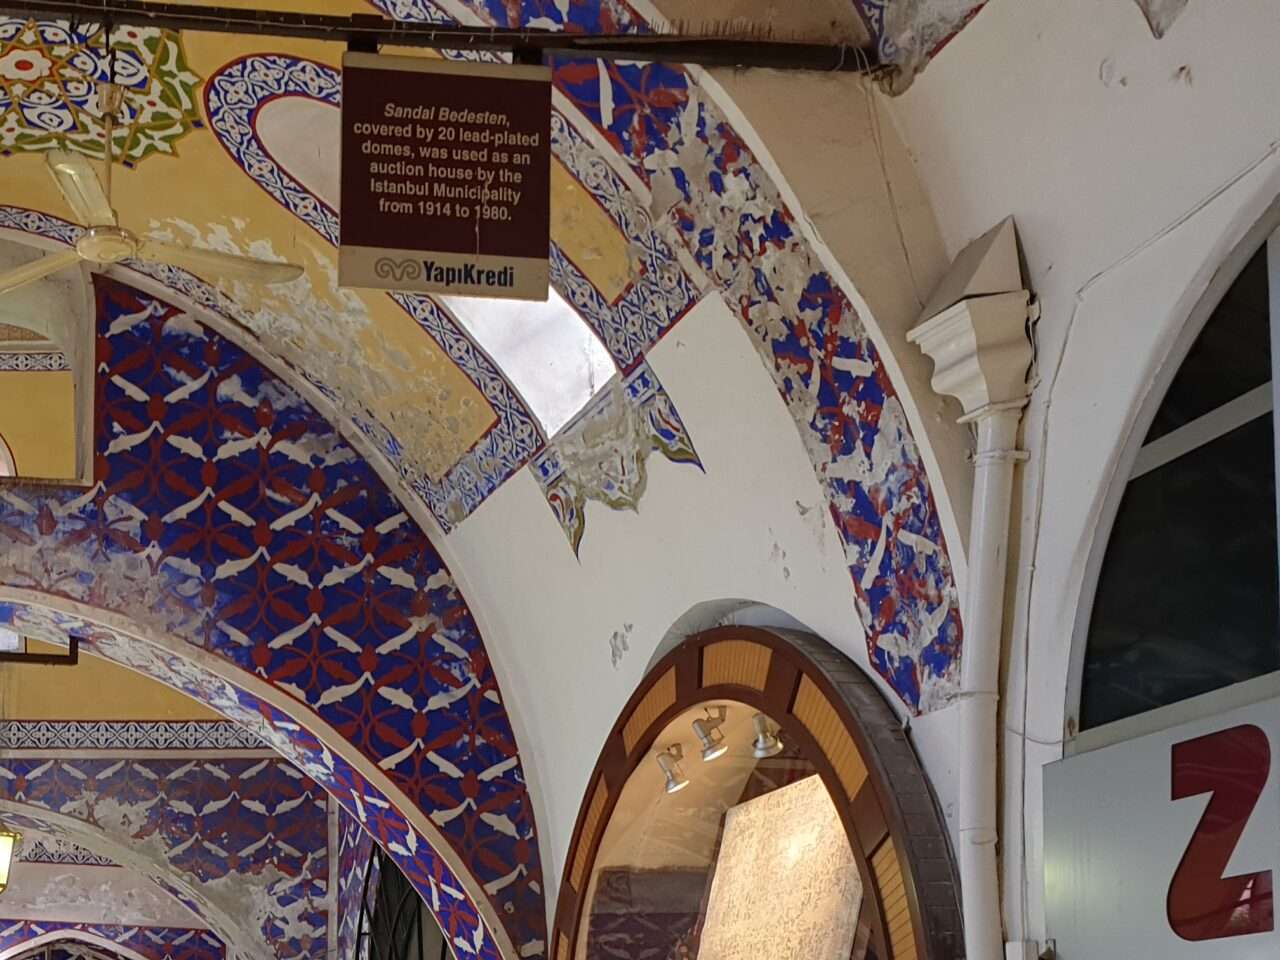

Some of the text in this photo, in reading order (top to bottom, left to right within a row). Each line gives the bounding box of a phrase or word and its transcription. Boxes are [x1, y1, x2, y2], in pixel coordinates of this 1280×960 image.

[384, 103, 511, 128] Sandal Bedesten,
[353, 122, 539, 147] covered by 20 lead-plated
[361, 140, 531, 165] domes, was used as an
[370, 161, 523, 184] auction house by the
[370, 177, 521, 206] Istanbul Municipality
[379, 198, 512, 221] from 1914 to 1980.
[423, 261, 514, 287] YapıKredi
